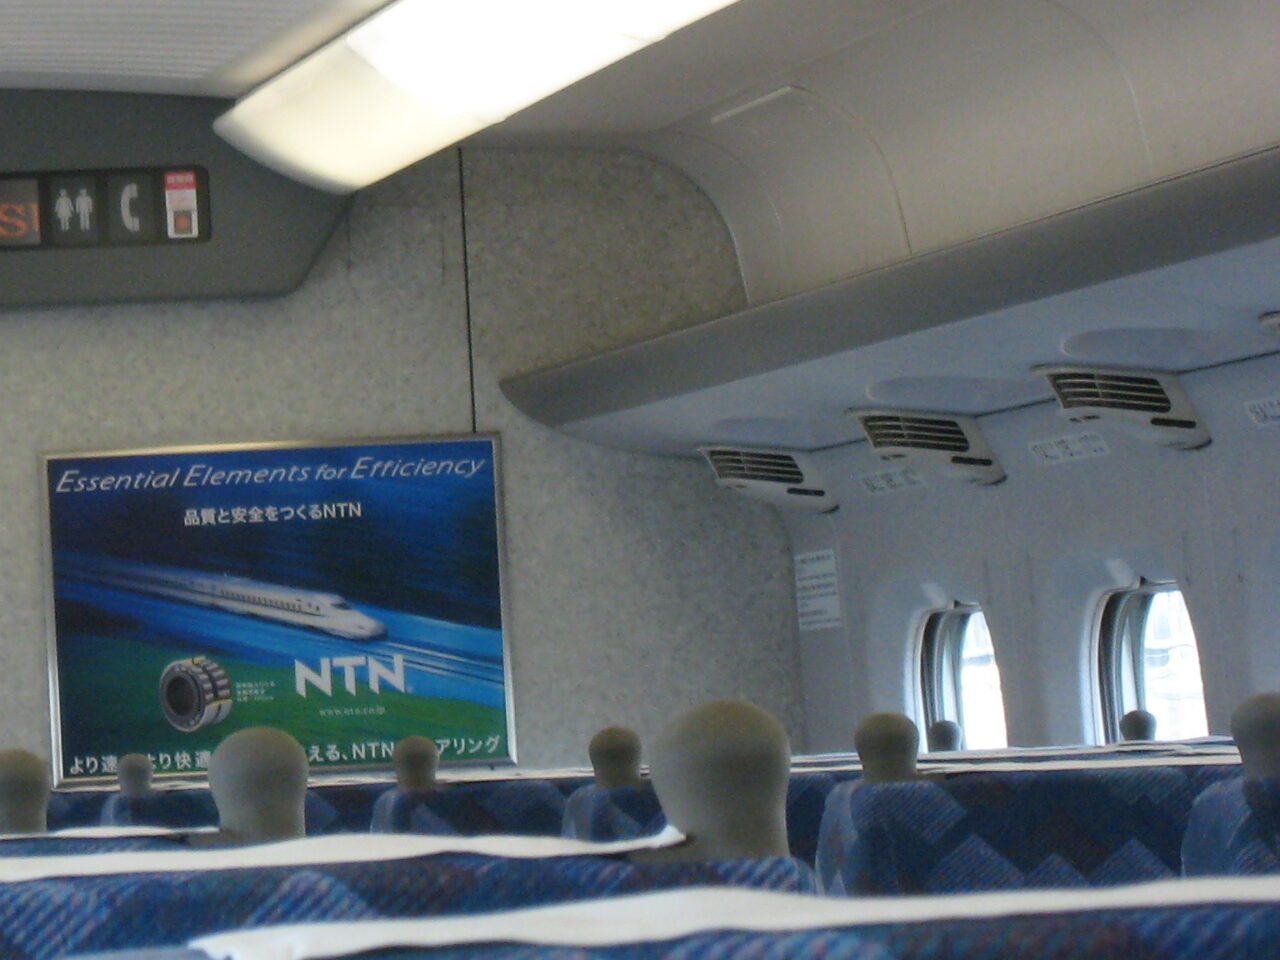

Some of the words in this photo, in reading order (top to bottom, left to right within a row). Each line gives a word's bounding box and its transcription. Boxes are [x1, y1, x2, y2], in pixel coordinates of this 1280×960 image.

[56, 467, 181, 493] Essential
[183, 463, 312, 487] Elements
[315, 464, 348, 481] for
[350, 456, 485, 479] Efficiency
[184, 502, 362, 527] 品質と安全をつくるNTN
[294, 654, 406, 698] NTN
